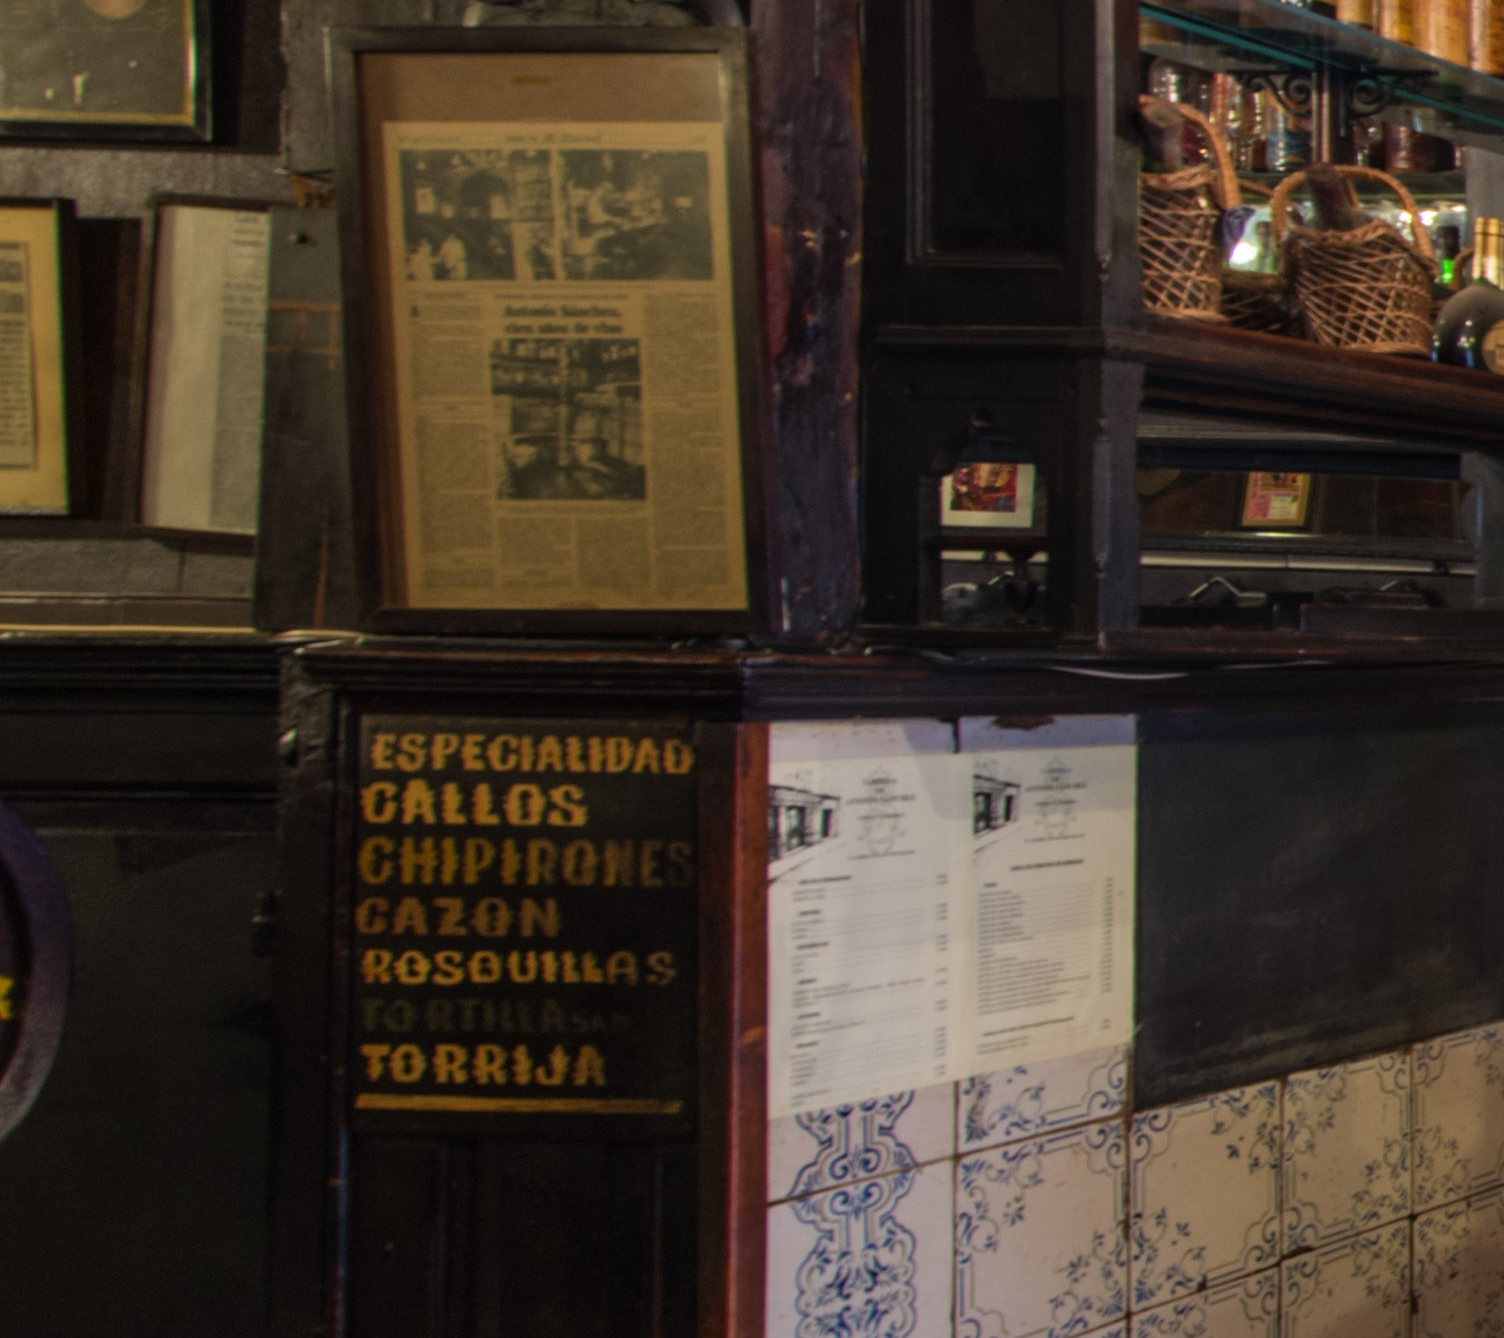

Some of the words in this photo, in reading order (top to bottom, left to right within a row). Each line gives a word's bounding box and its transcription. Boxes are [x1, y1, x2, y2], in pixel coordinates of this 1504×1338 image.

[370, 734, 694, 774] ESPECIALIDAD
[361, 778, 589, 827] CALLOS
[358, 836, 694, 888] CHIPIRONES
[355, 896, 562, 938] CAZON
[360, 1043, 608, 1087] TORRIJA
